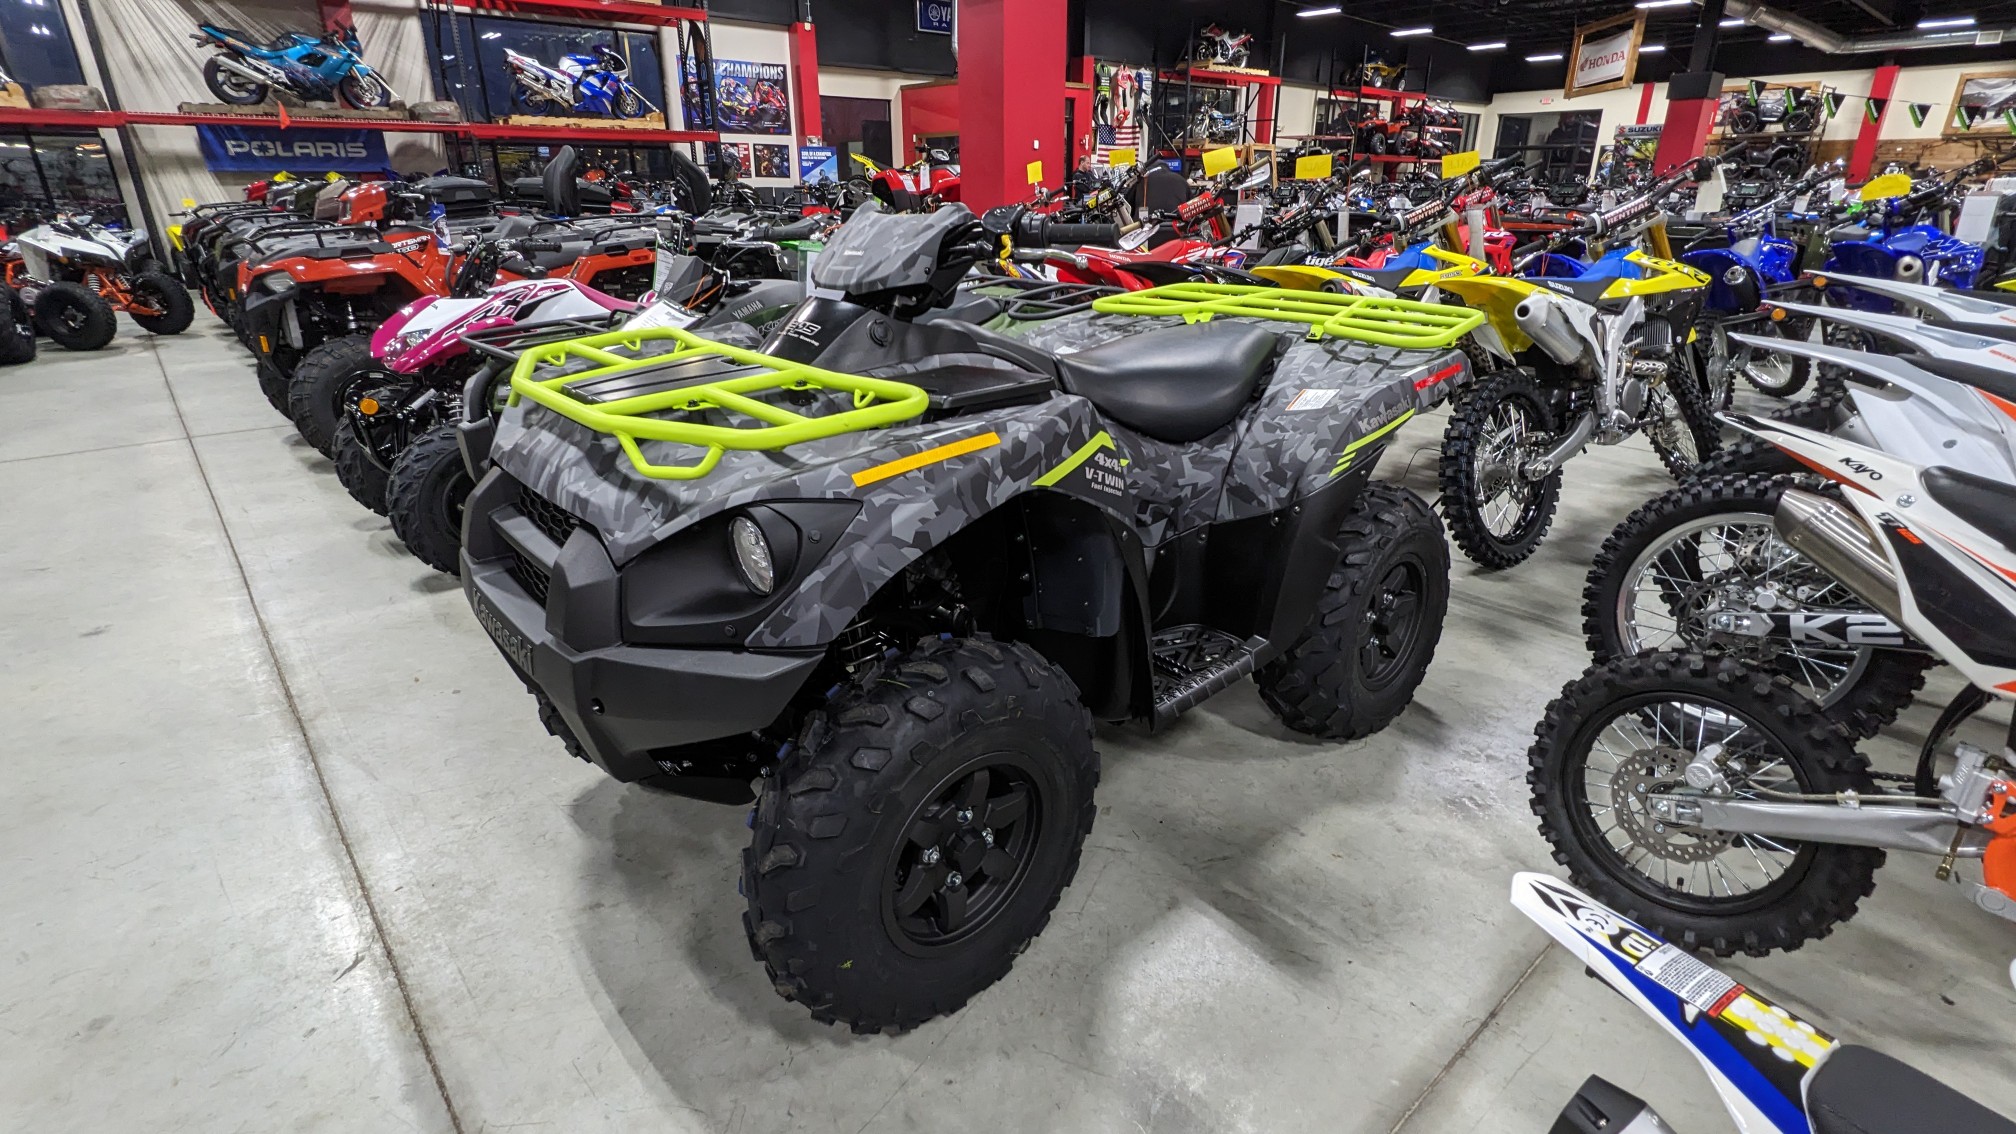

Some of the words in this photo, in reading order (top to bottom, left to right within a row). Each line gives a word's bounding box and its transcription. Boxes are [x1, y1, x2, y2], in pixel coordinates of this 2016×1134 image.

[1588, 50, 1626, 69] HONDA
[720, 62, 784, 80] CHAMPIONS
[225, 140, 368, 158] POLARIS
[1405, 199, 1441, 219] RENTHAL
[1409, 203, 1444, 225] RENTHAL
[1607, 200, 1650, 226] RENTHAL
[1108, 253, 1131, 263] HONDA
[1351, 270, 1376, 282] SUZUKI
[1548, 281, 1574, 294] SUZUKI
[732, 300, 764, 319] YAMAHA
[1357, 396, 1412, 435] Kawasaki
[1085, 466, 1124, 490] V-TWIN
[1838, 457, 1883, 480] KAYO
[1091, 482, 1102, 490] Fuel
[1103, 486, 1122, 497] Injected
[473, 587, 533, 676] Kawasaki
[1789, 614, 1904, 645] K2
